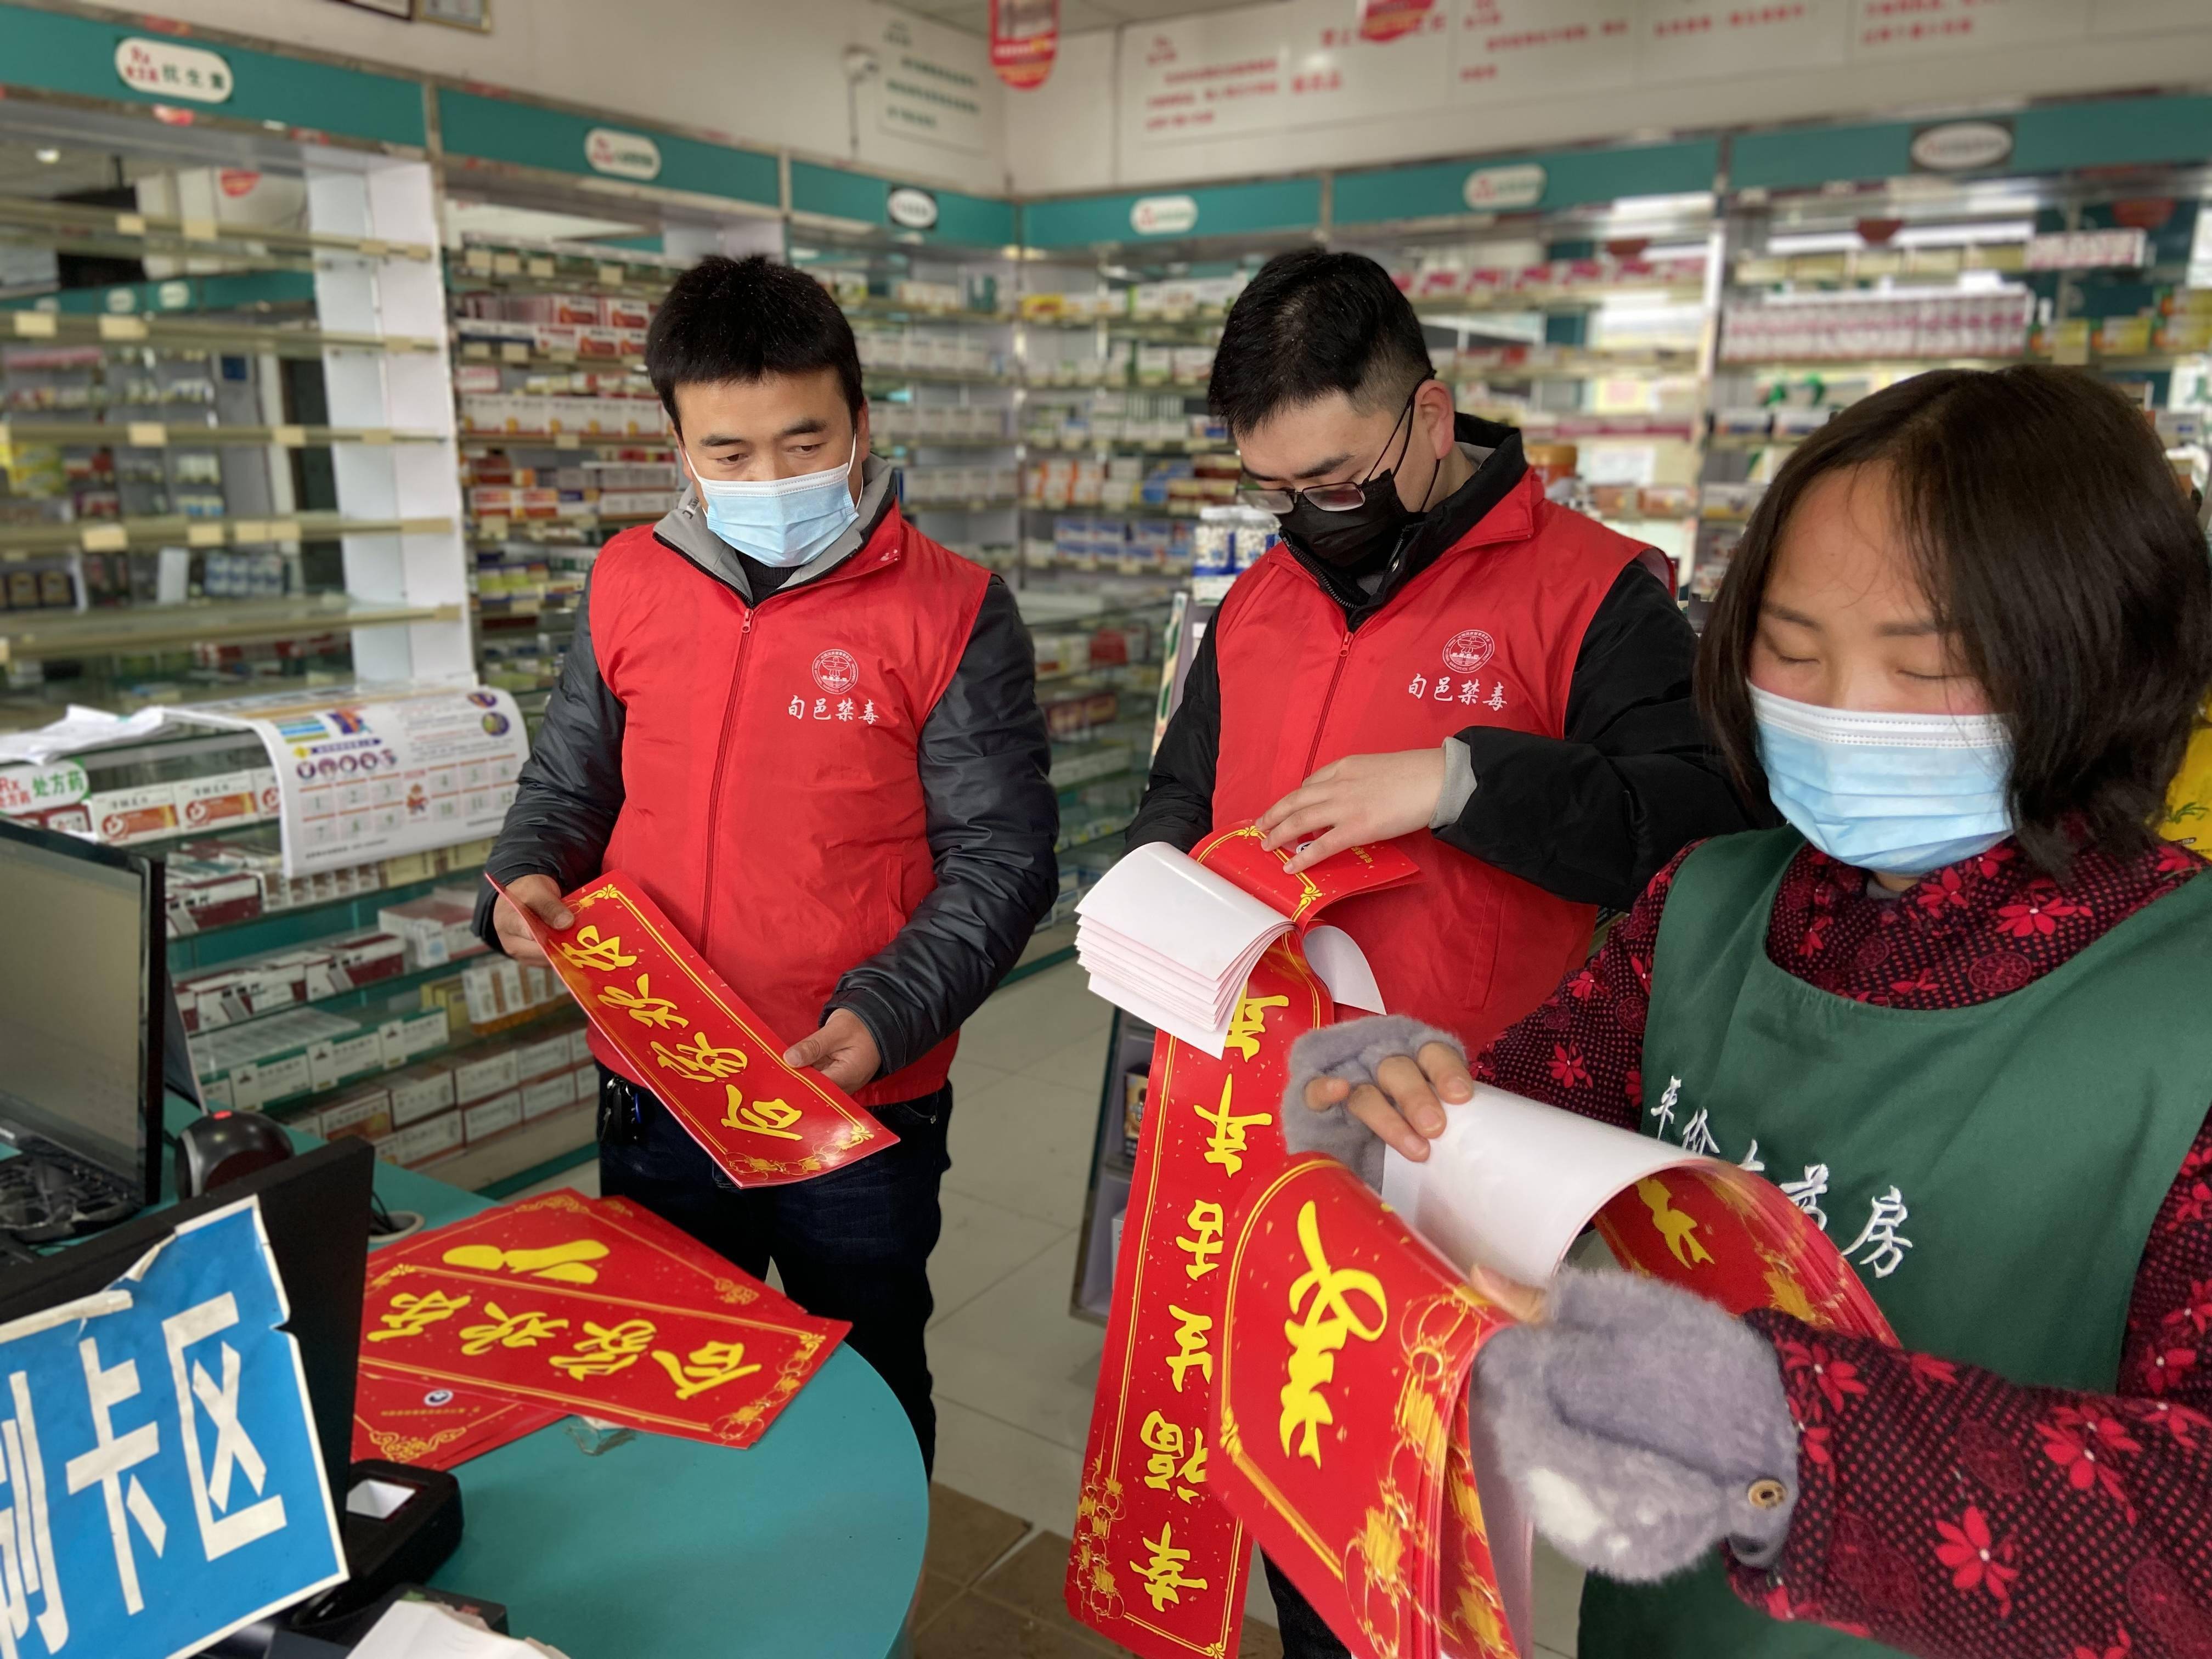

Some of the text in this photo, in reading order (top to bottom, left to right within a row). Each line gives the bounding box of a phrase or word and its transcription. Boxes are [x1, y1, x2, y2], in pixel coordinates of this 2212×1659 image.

[788, 695, 879, 725] 旬邑禁毒
[1408, 673, 1508, 711] 旬邑禁毒
[33, 770, 83, 796] 处方药
[560, 925, 803, 1141] 合家欢乐
[366, 1290, 762, 1400] 合家欢乐
